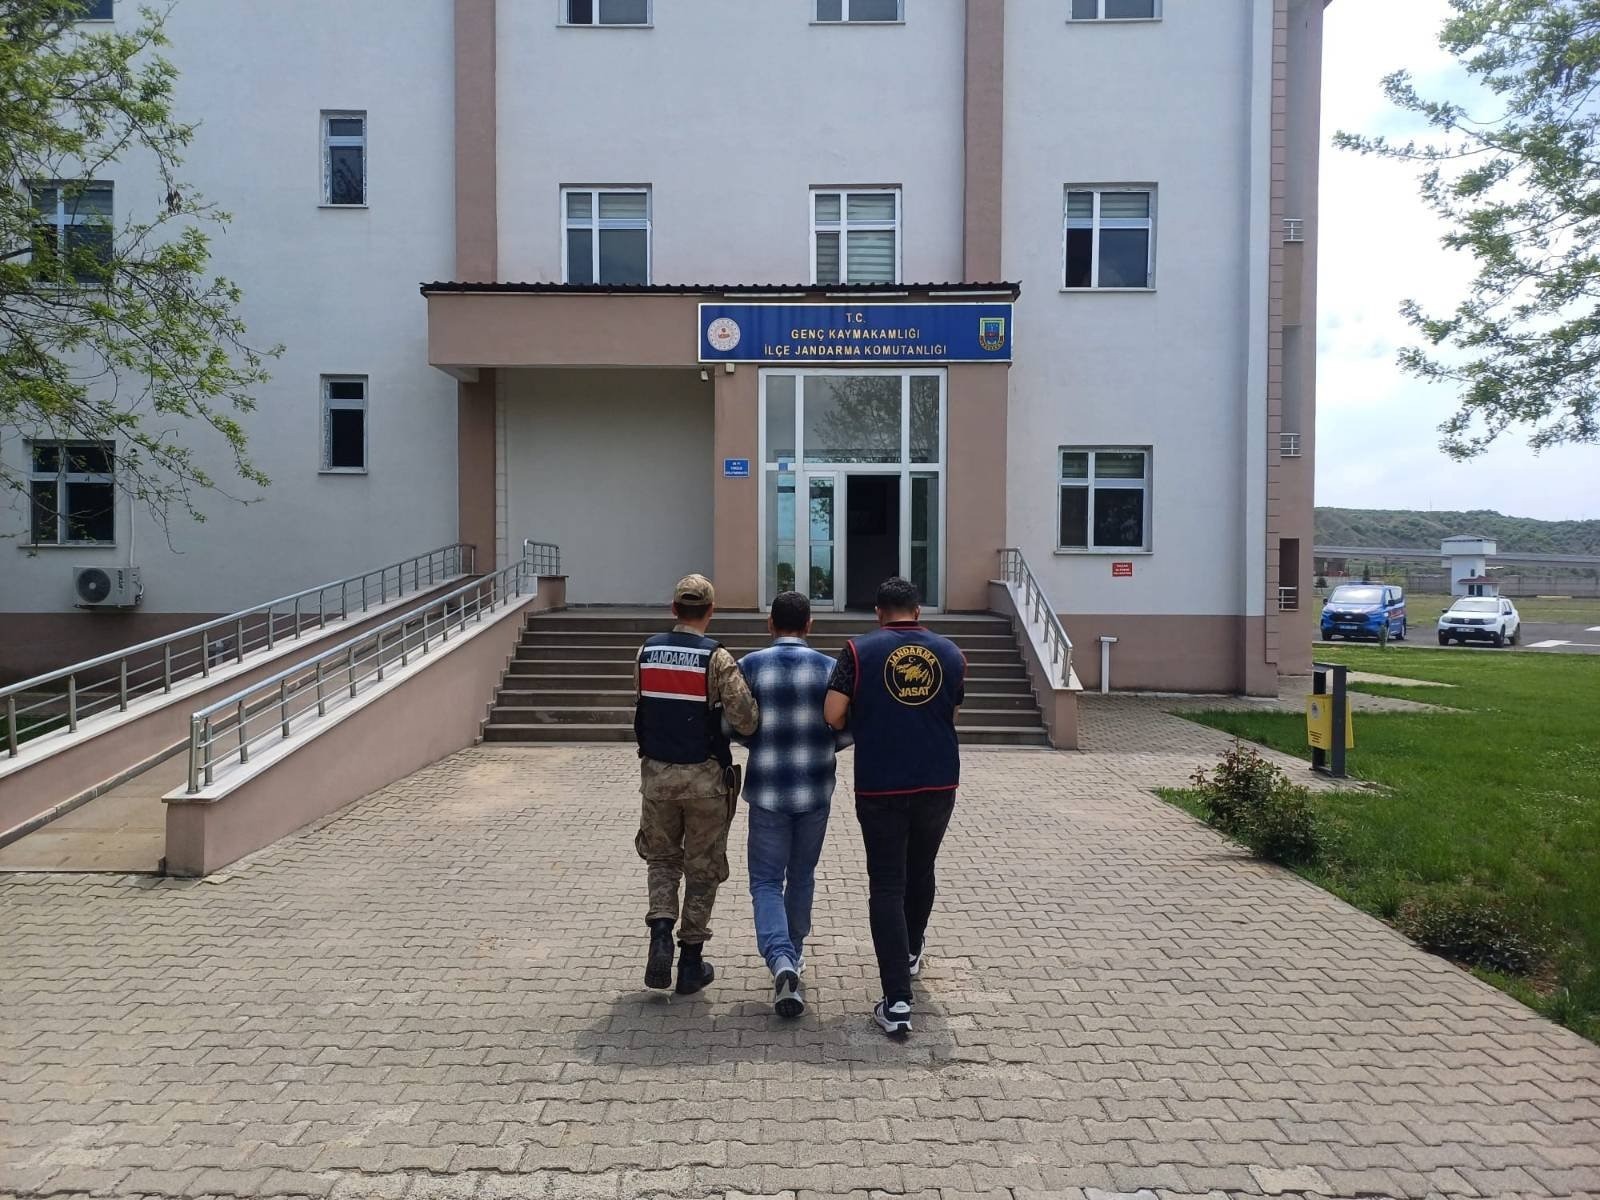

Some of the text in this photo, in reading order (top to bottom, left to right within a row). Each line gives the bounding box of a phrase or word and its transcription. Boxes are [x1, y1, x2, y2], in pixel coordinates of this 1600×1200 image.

[790, 328, 921, 342] GENÇ KAYMAKAMLIĞI
[764, 343, 791, 358] İLÇE
[794, 345, 861, 356] JANDARMA
[646, 650, 700, 667] JANDARMA
[889, 647, 936, 667] JANDARMA
[898, 686, 931, 698] JASAT
